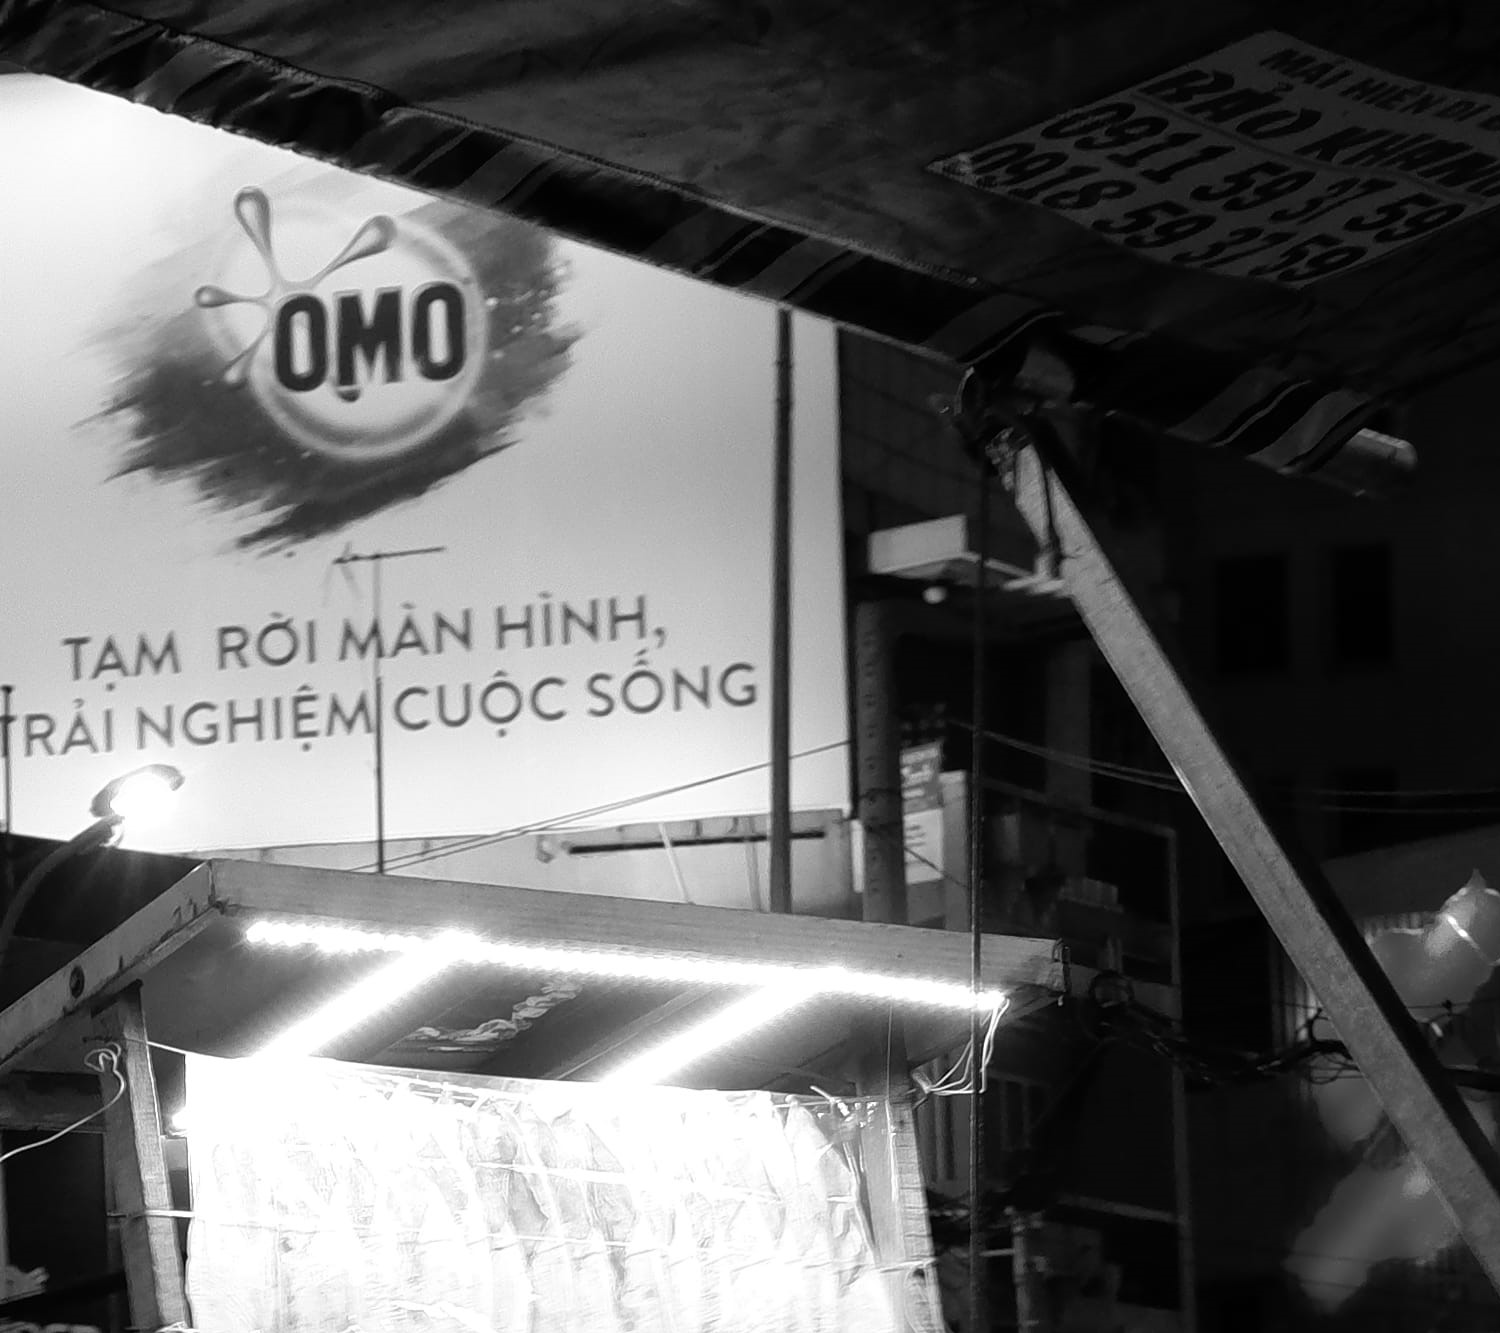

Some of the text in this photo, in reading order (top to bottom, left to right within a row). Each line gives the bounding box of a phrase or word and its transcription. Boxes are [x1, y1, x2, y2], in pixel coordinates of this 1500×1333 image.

[1041, 102, 1467, 243] 0911 59 37 59
[1091, 200, 1216, 249] 59
[1171, 225, 1297, 268] 37
[1249, 233, 1368, 282] 59
[275, 281, 466, 395] OMO
[61, 591, 667, 692] TẠM RỜI MÀN HÌNH,
[137, 684, 375, 752] NGHIỆM
[394, 670, 567, 738] CUỘC
[587, 649, 758, 718] SỐNG
